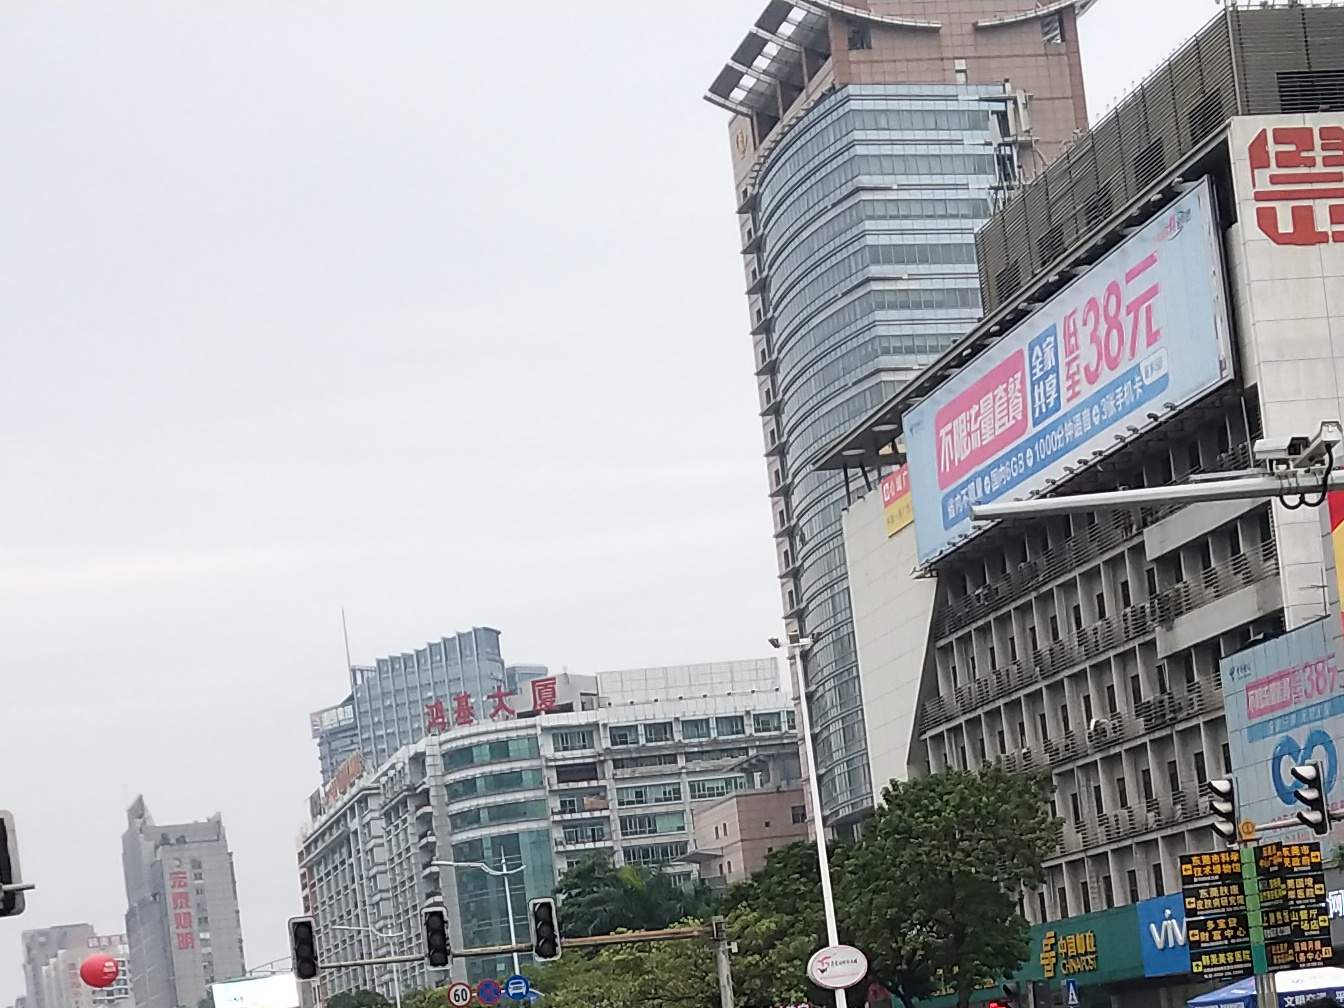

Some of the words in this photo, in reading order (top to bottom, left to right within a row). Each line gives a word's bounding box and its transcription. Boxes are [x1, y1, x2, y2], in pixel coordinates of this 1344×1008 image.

[1082, 250, 1162, 386] 38元
[425, 676, 556, 735] 鸿基大厦
[1149, 909, 1187, 950] viv
[453, 988, 469, 1002] 60
